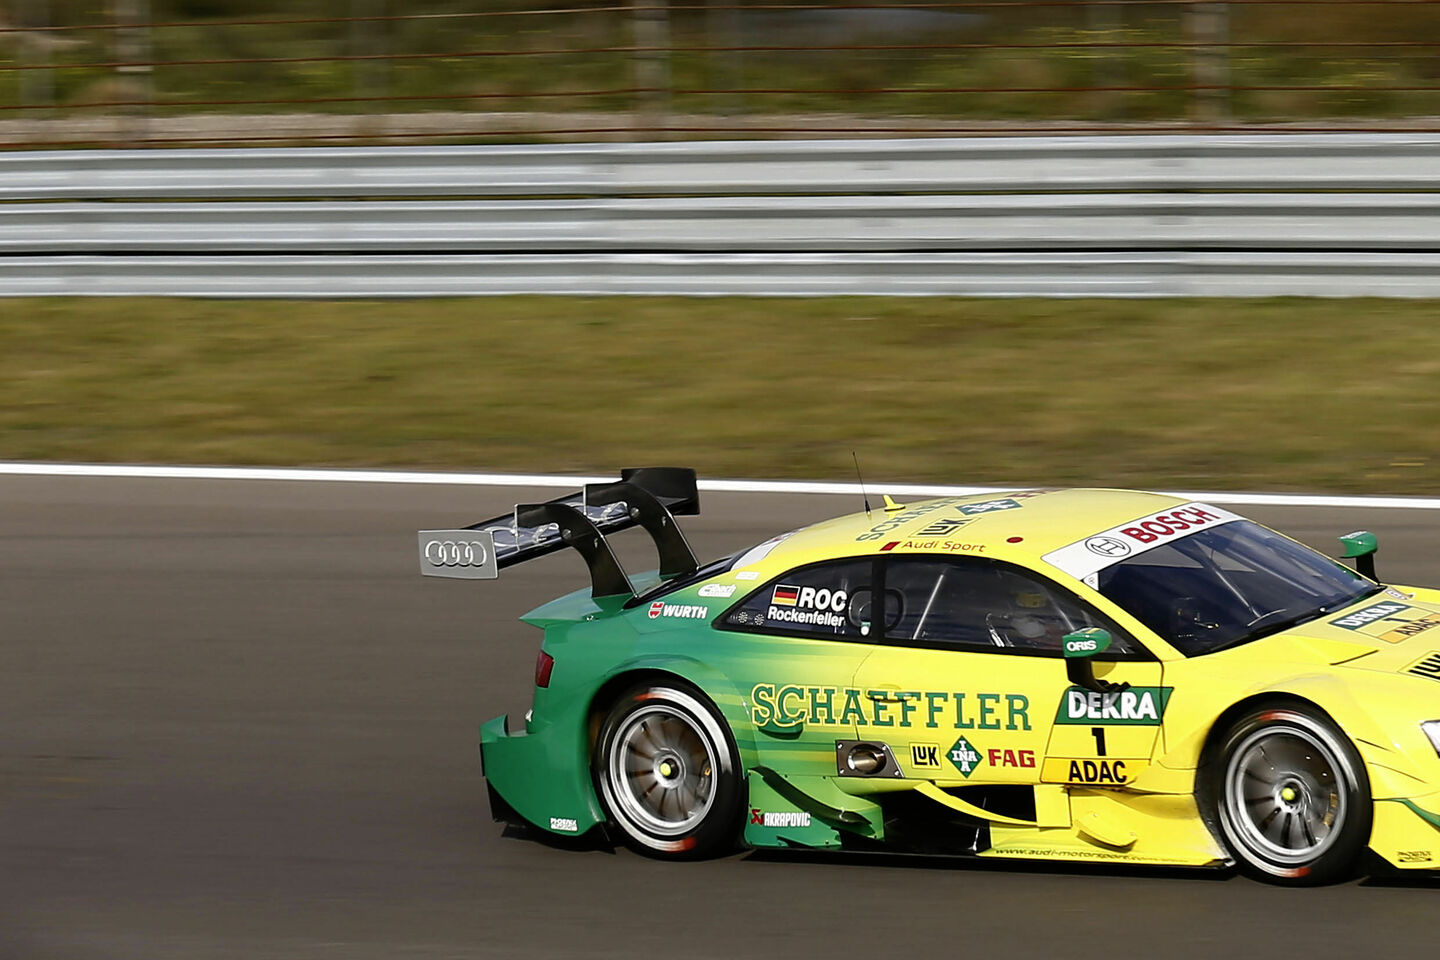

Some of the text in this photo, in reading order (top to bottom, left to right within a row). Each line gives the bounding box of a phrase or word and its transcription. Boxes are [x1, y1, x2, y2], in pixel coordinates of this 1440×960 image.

[1119, 506, 1221, 543] BOSCH
[901, 540, 987, 553] Audi Sport
[800, 587, 847, 612] ROC
[767, 606, 845, 627] Rockenfeller
[1334, 604, 1406, 627] DEKRA
[1066, 640, 1097, 652] ORIS
[751, 683, 1032, 731] SCHAEFFLER
[1068, 691, 1158, 720] DEKRA
[1091, 727, 1107, 756] 1
[988, 749, 1036, 768] FAG
[1069, 760, 1127, 784] ADAC
